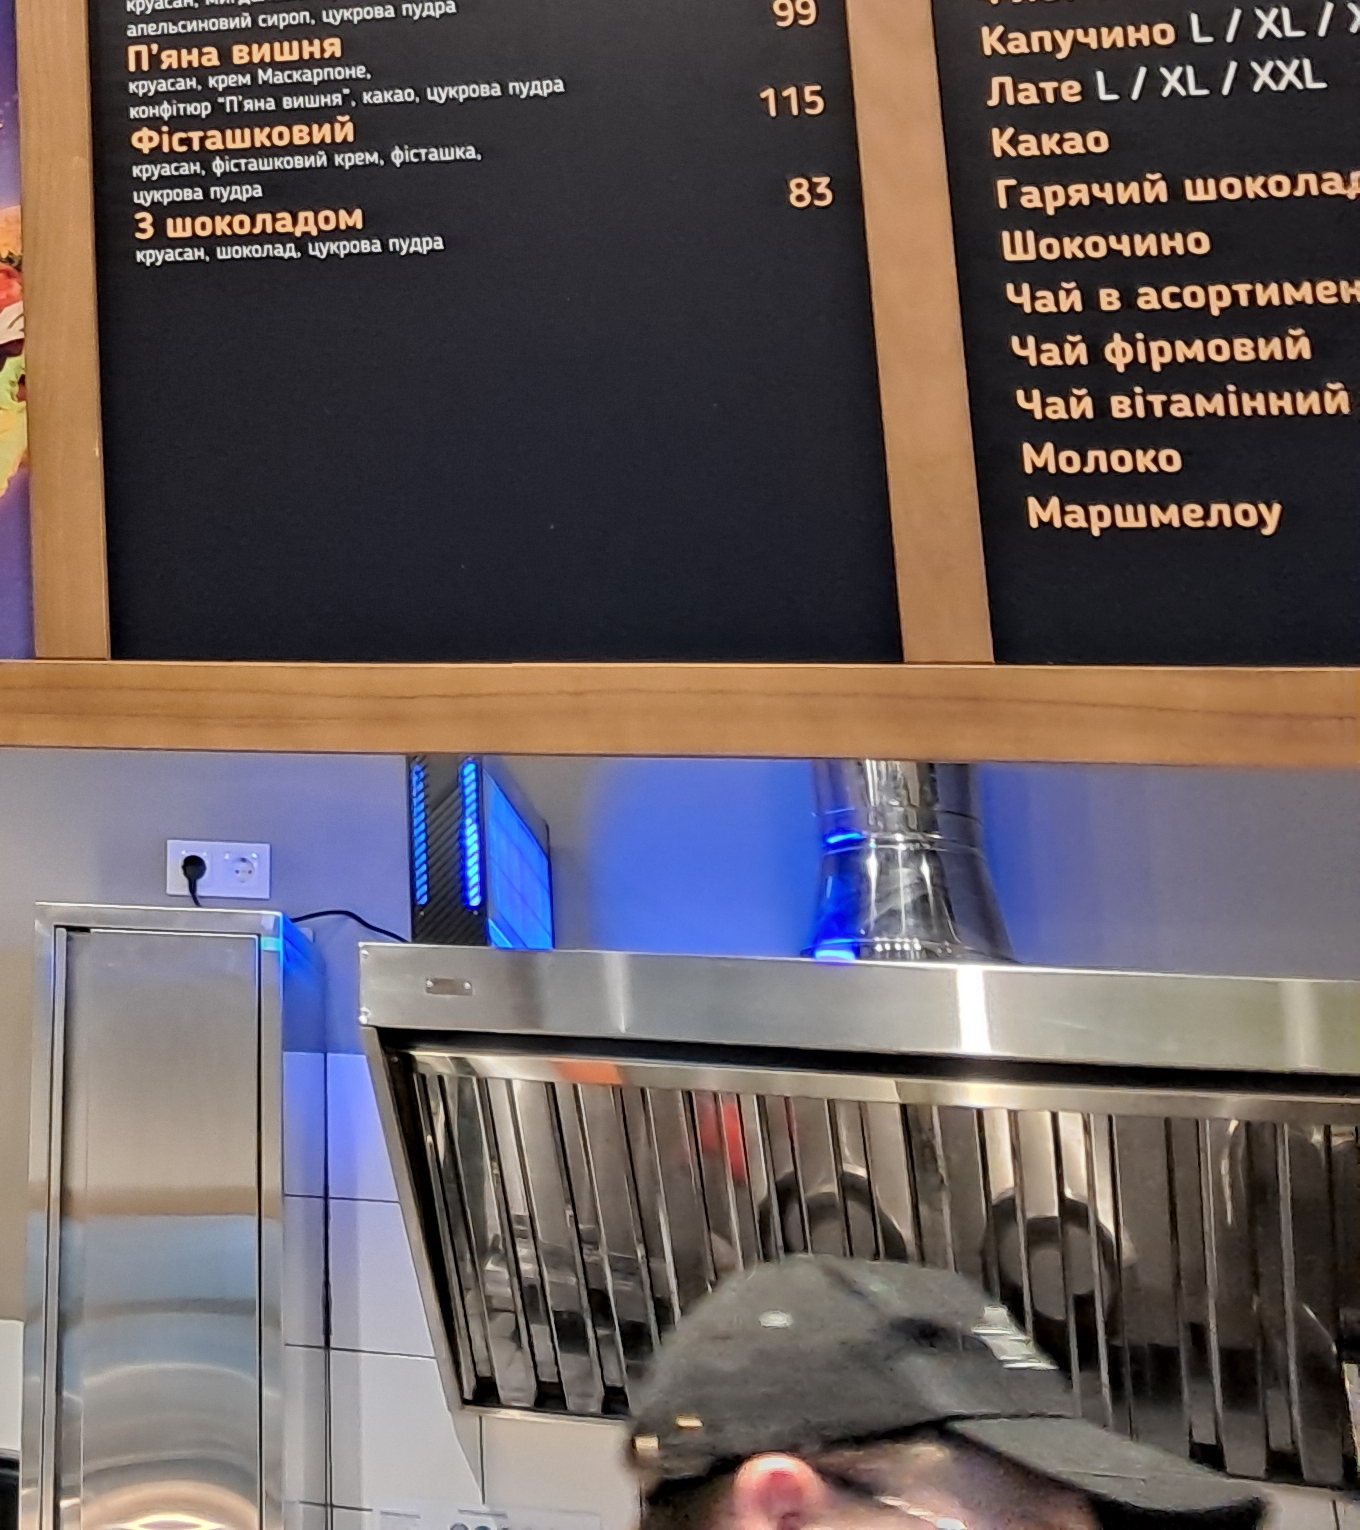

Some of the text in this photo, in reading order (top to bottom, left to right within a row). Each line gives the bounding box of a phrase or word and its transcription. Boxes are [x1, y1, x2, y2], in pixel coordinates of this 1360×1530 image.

[126, 0, 457, 37] апельсиновий сироп, цукрова пудра
[232, 37, 342, 65] вишня
[759, 84, 825, 117] 115
[131, 114, 354, 155] Фісташковий
[991, 126, 1110, 158] Какао
[789, 176, 833, 208] 83
[996, 172, 1169, 214] Гарячий
[166, 208, 363, 238] шоколадом
[1001, 230, 1211, 261] Шокочино
[1010, 327, 1312, 373] Чай фірмовий
[1015, 382, 1351, 420] Чай вітамінний
[1027, 495, 1282, 537] Маршмелоу
